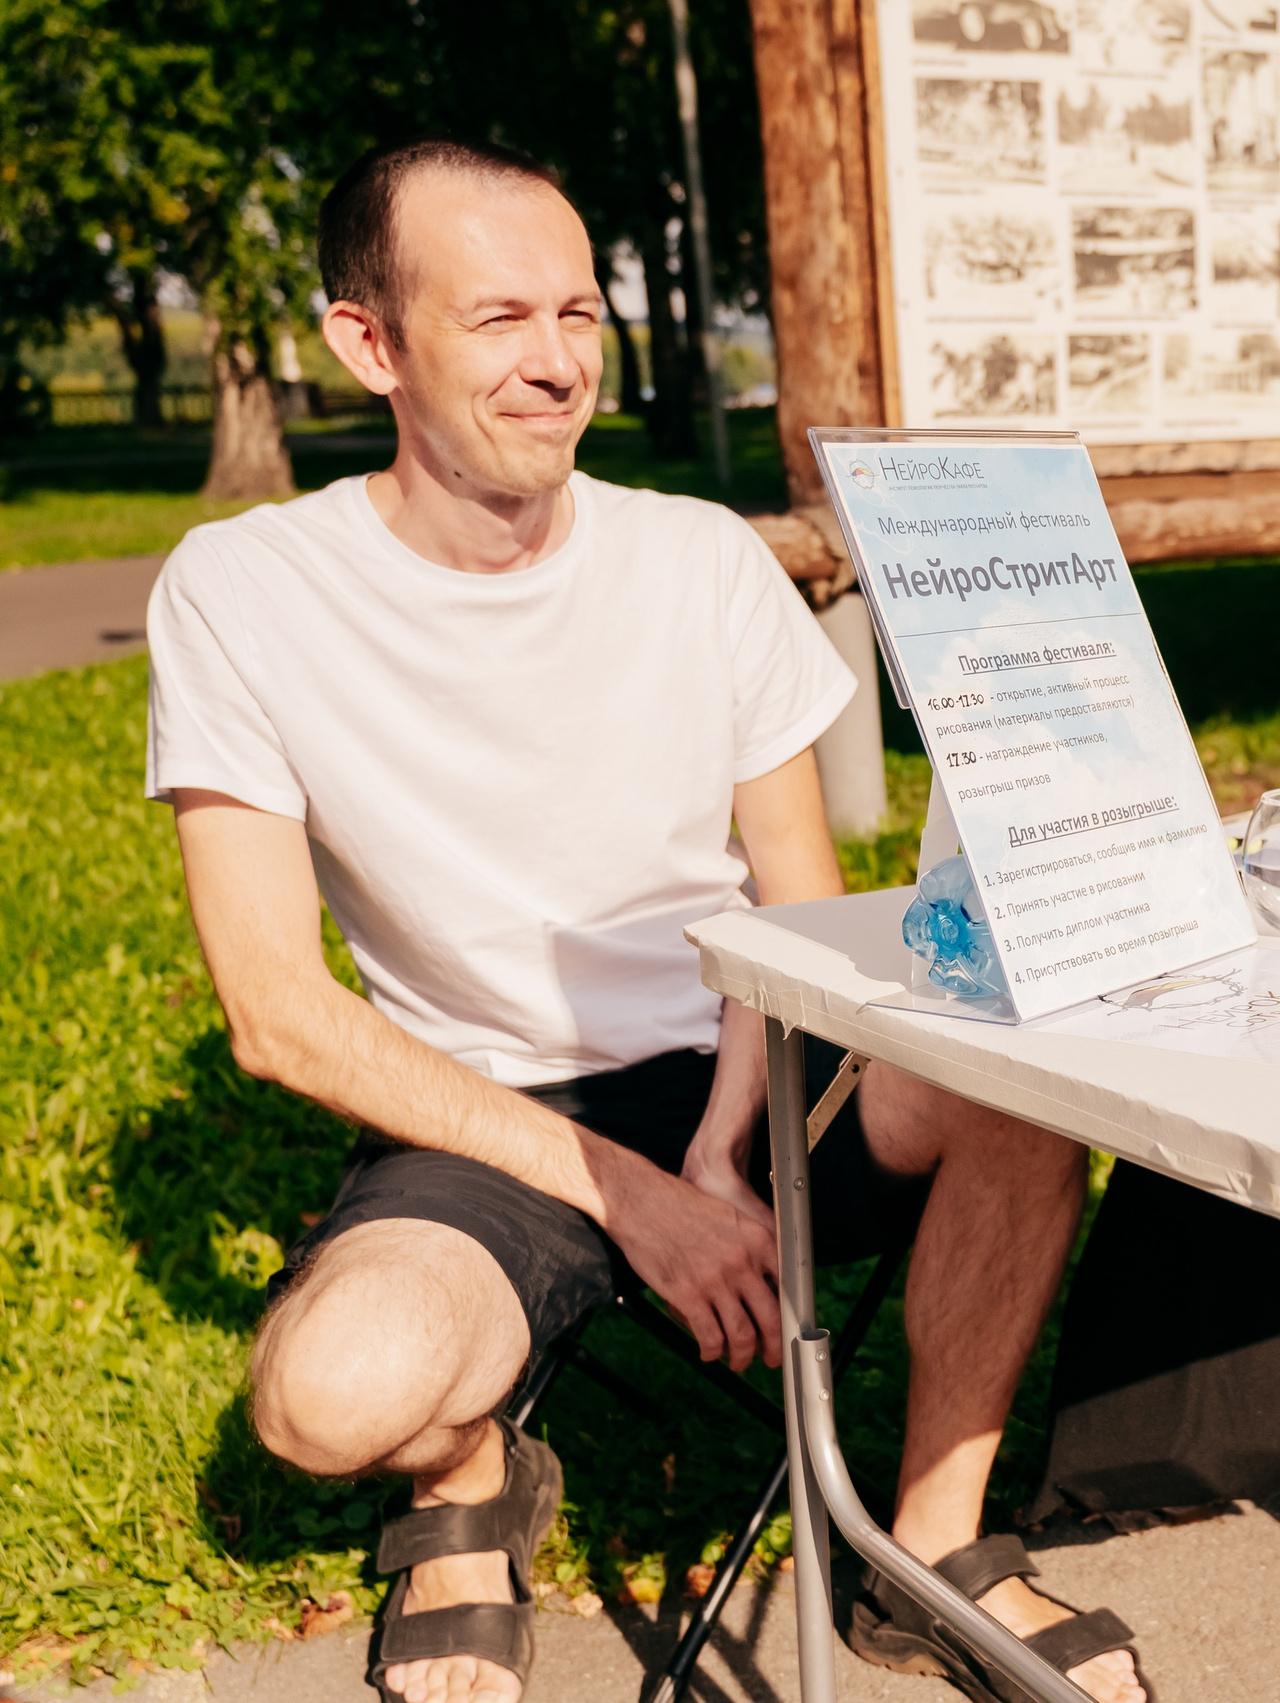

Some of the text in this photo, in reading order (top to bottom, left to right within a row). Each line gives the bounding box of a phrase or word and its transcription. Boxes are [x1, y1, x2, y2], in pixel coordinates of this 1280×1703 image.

[877, 511, 1091, 538] Международный фестиваль
[882, 552, 1118, 602] НейроСтритАрт
[958, 641, 1115, 674] Программа фестиваля:
[996, 685, 1047, 702] открытие,
[1047, 677, 1092, 694] активный
[1092, 674, 1130, 691] процесс
[936, 694, 1135, 739] рисования (материалы предоставляются)
[946, 751, 977, 768] 17.30
[985, 741, 1053, 762] награждение
[1053, 731, 1108, 753] участников,
[958, 772, 1052, 803] розыгрыш призов
[1008, 795, 1178, 847] Для участия в розыгрыше:
[983, 823, 1208, 887] 1. Зарегистрироваться, сообщив имя и фамилию
[994, 871, 1146, 920] 2. Принять участие в рисовании
[1004, 903, 1151, 952] 3. Получить диплом участника
[1014, 919, 1199, 985] 4. Присутствовать во время розыгрыша
